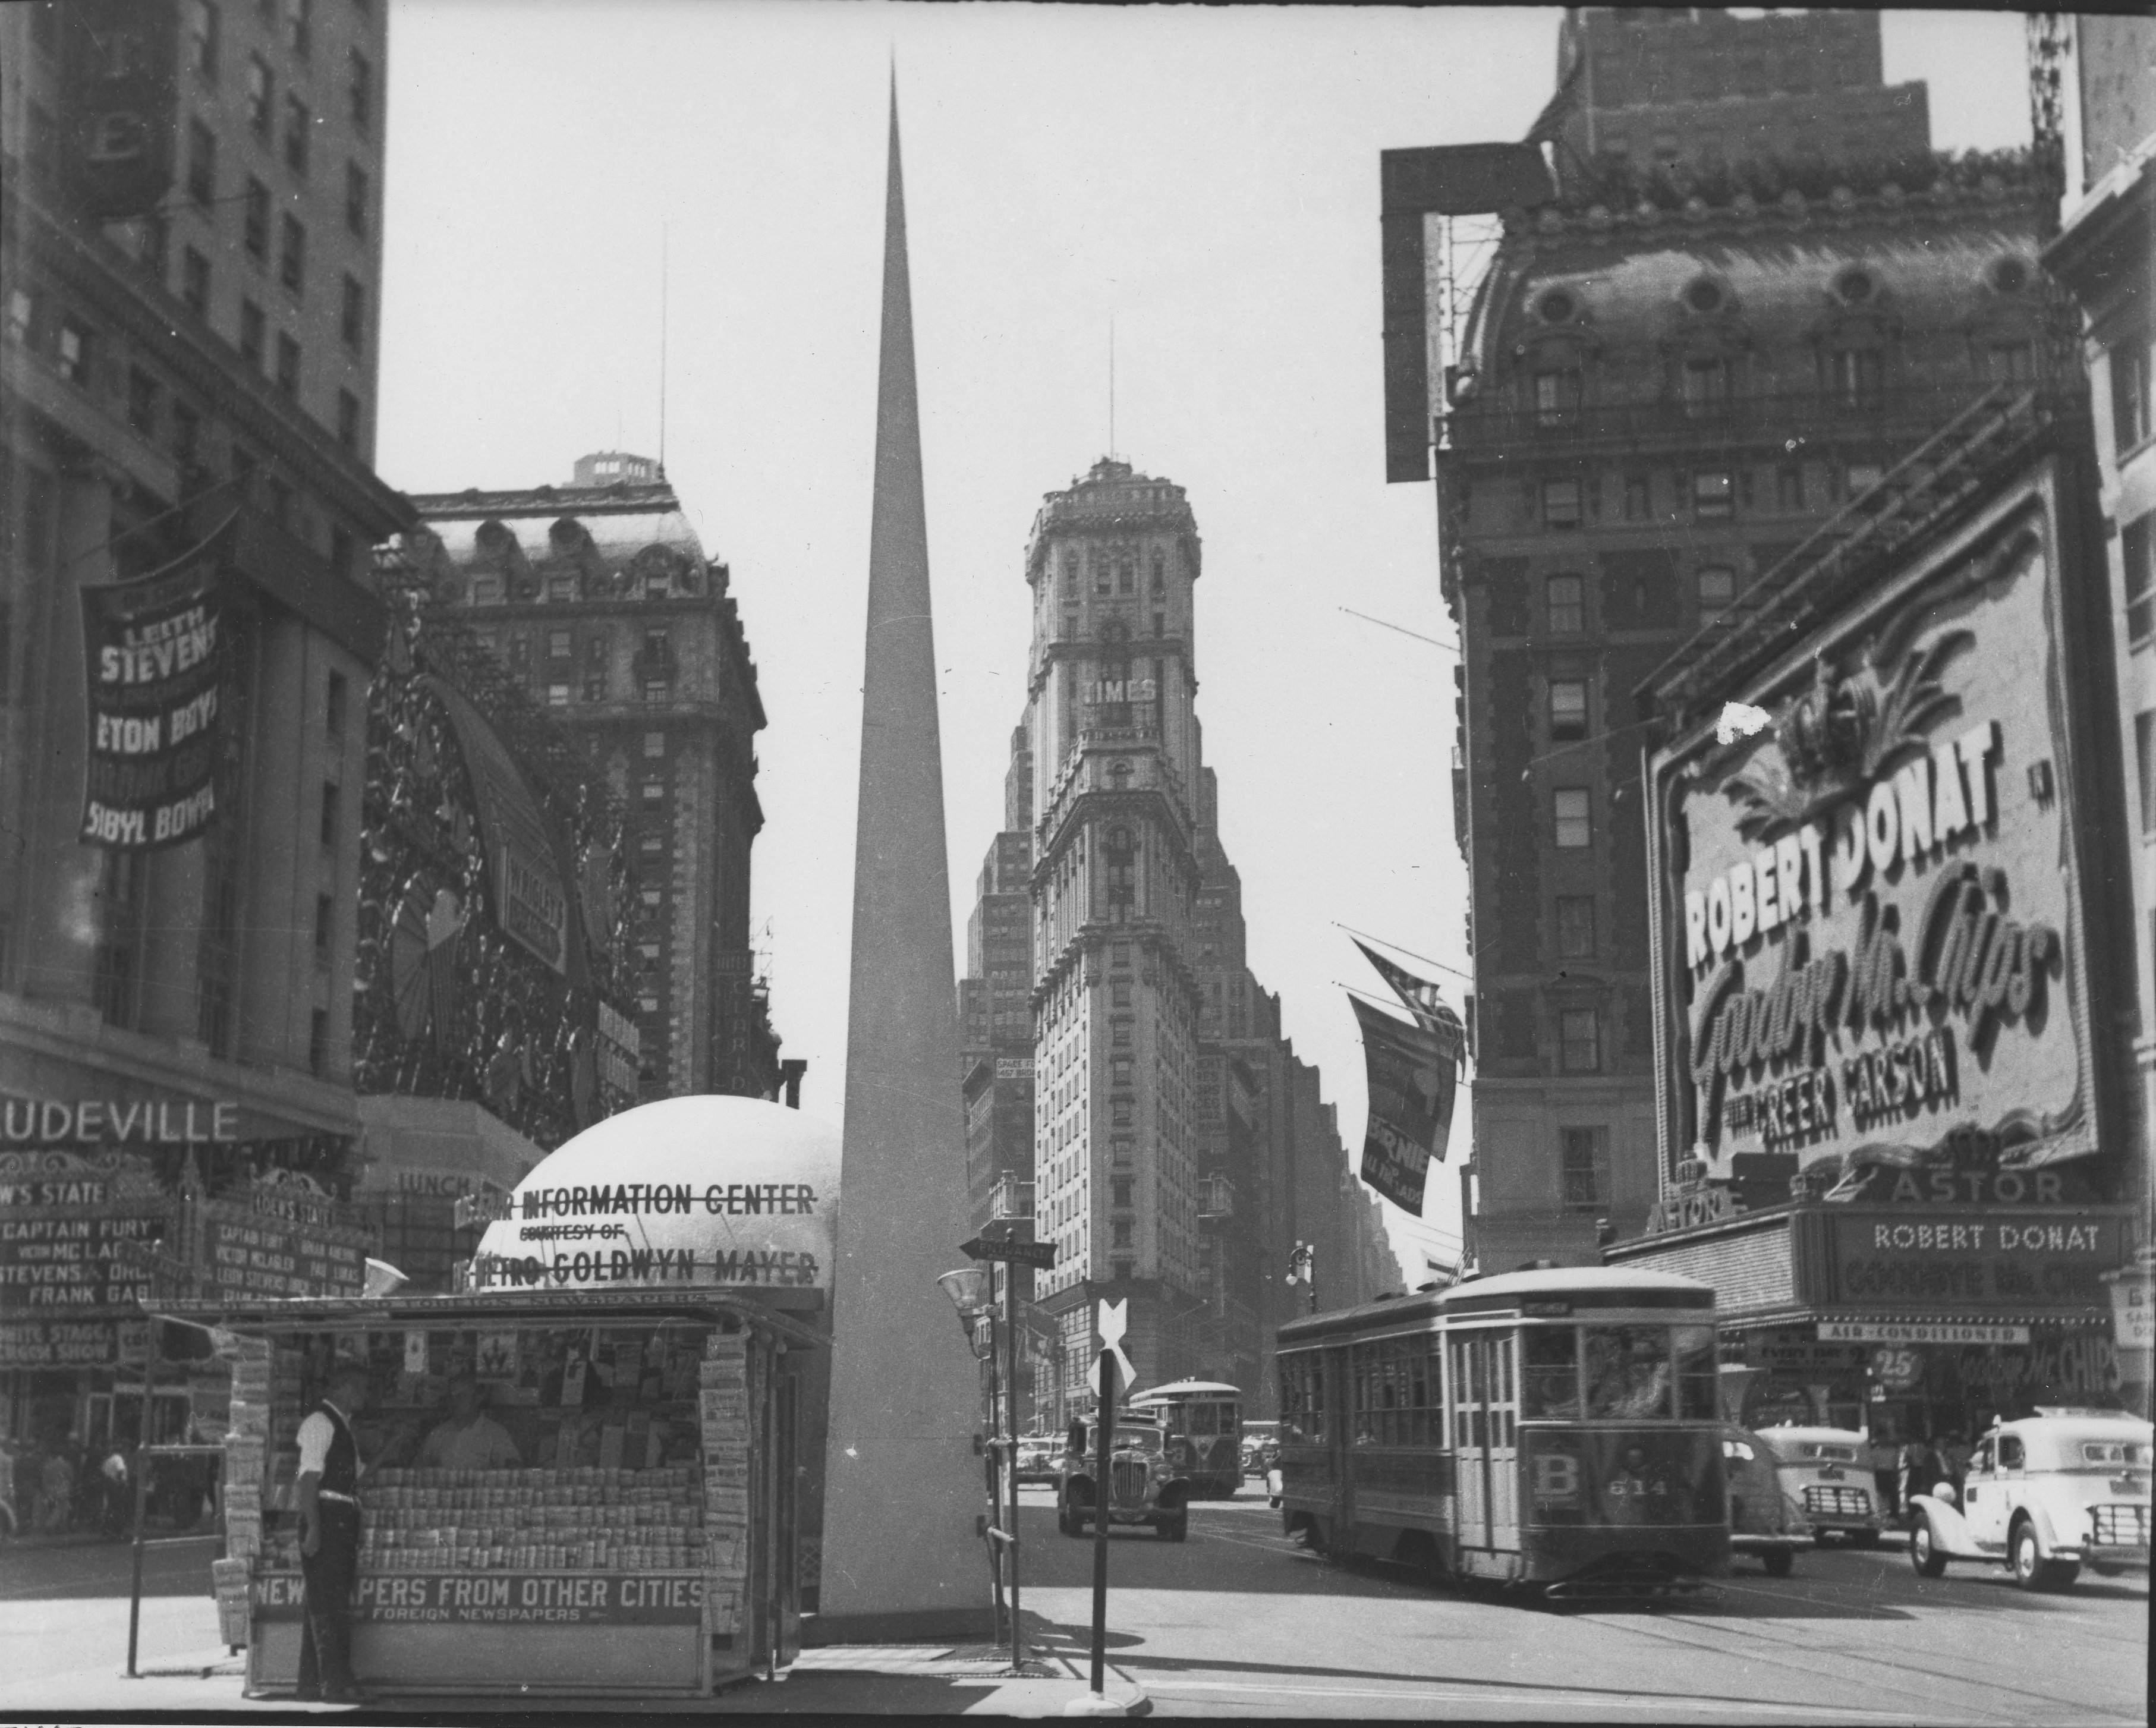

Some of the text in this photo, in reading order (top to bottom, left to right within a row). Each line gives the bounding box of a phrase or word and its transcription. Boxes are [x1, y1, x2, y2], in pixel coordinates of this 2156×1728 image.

[125, 605, 205, 647] LEITH
[1085, 678, 1157, 703] TIMES
[97, 712, 160, 753] ETON
[86, 801, 147, 844] SIBYL
[1685, 824, 1826, 970] ROBERT
[42, 1182, 105, 1203] STATE
[400, 1174, 471, 1195] LUNCH
[1891, 1169, 2063, 1203] ASTOR
[523, 1184, 691, 1220] INFORMATION
[705, 1184, 815, 1216] CENTER
[520, 1223, 624, 1242] COURTESY OF
[1875, 1225, 2100, 1251] ROBERT DONAT
[553, 1249, 694, 1285] GOLDWYN
[714, 1249, 815, 1285] MAYER
[29, 1285, 96, 1304] FRANK
[1534, 1454, 1579, 1494] B
[1609, 1480, 1667, 1496] 614
[438, 1578, 509, 1606] FROM
[521, 1578, 608, 1606] OTHER
[621, 1579, 703, 1607] CITIES
[373, 1607, 581, 1623] FOREIGN NEWSPAPERS
